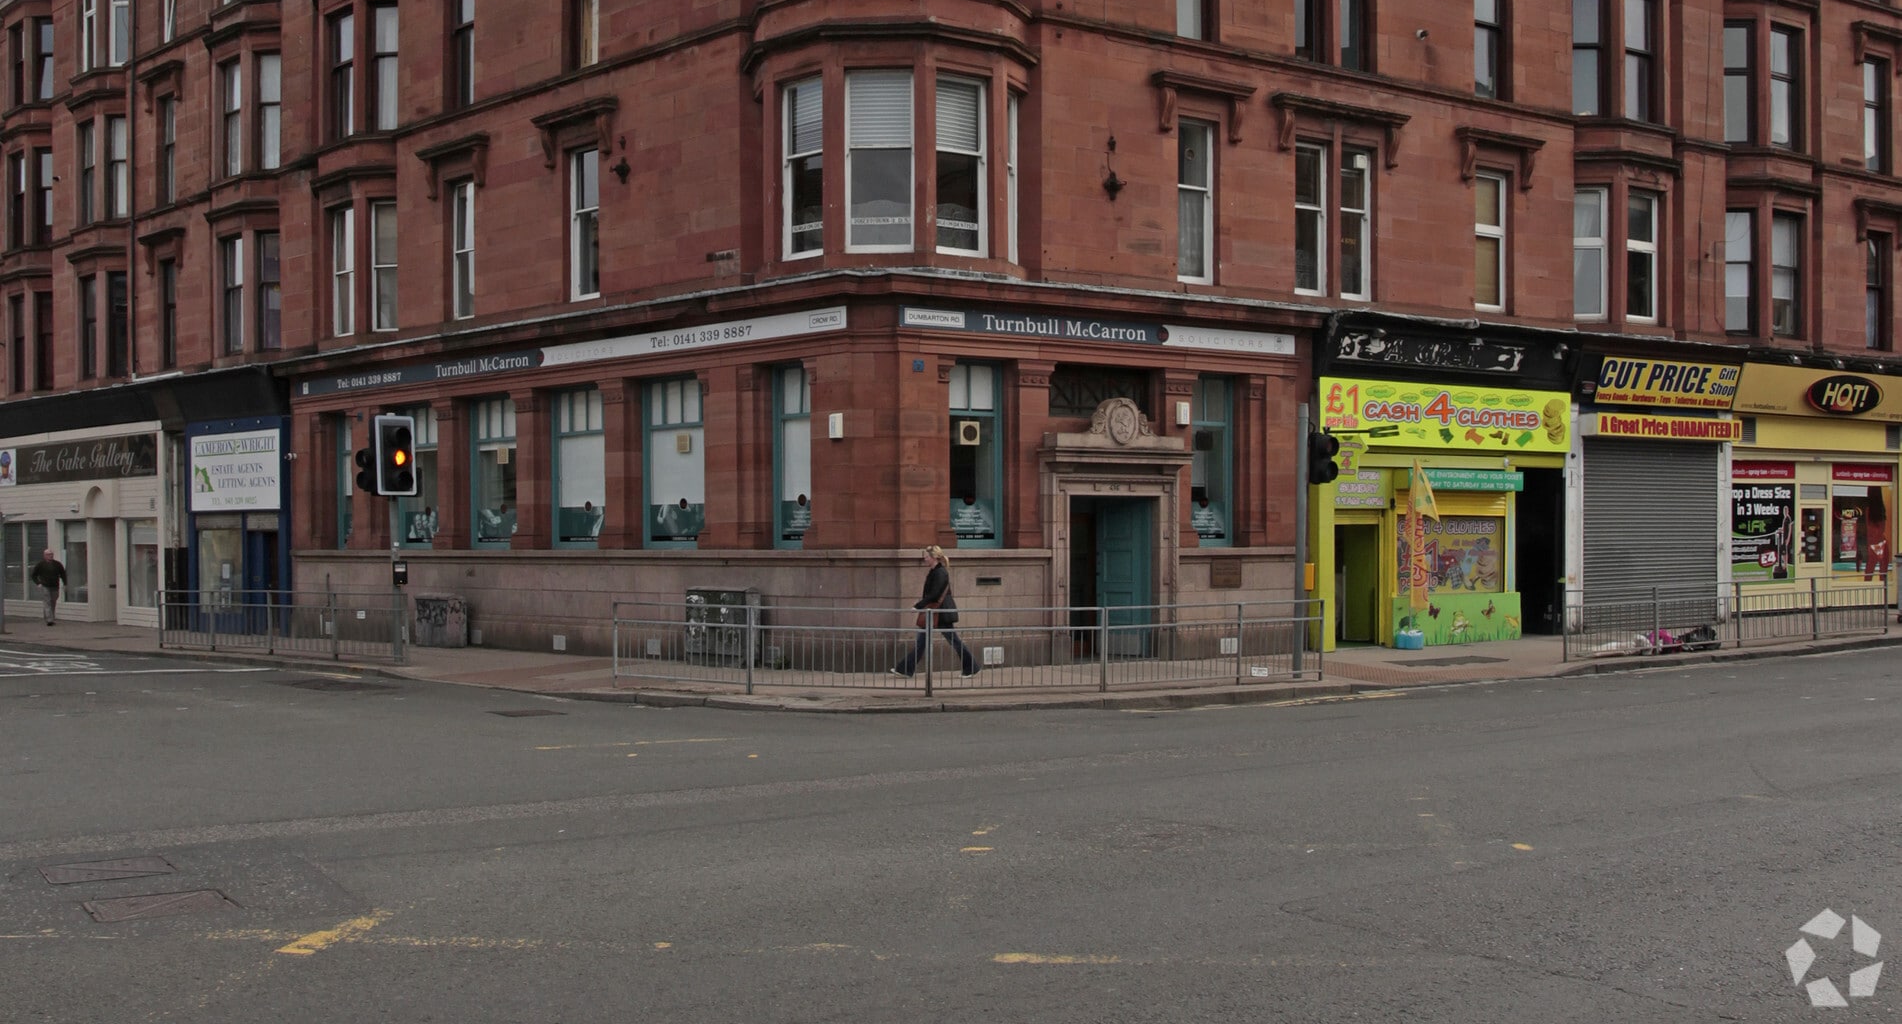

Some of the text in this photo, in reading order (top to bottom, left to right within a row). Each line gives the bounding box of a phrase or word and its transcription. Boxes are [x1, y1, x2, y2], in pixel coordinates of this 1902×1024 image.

[811, 315, 827, 325] CROW
[908, 312, 946, 324] DUMBARTON
[983, 313, 1147, 342] Turnbull McCarron
[650, 325, 753, 349] Tel: 0141 339 8887
[1178, 333, 1267, 350] SOLICITORS
[435, 355, 530, 378] Turnbull McCarron
[1719, 367, 1738, 381] Gift
[337, 371, 402, 389] Tel: 0141 339 8887
[1598, 358, 1713, 394] CUT PRICE
[1709, 382, 1736, 397] Shop
[1822, 382, 1870, 409] HOT!
[1325, 383, 1359, 415] £1
[1597, 391, 1612, 401] Fancy
[1612, 392, 1628, 401] Goods
[1632, 394, 1656, 403] Hardware
[1659, 395, 1671, 404] Toys
[1702, 398, 1716, 406] Much
[1363, 391, 1542, 429] CASH 4 CLOTHES
[1600, 416, 1608, 433] A
[1610, 416, 1639, 434] Great
[1642, 420, 1669, 435] Price
[1671, 421, 1731, 438] GUARANTEED
[195, 440, 233, 455] CAMERON
[240, 437, 276, 451] WRIGHT
[30, 442, 135, 476] The Cake Gallery
[211, 462, 263, 475] ESTATE AGENTS
[218, 476, 276, 489] LETTING AGENTS
[1339, 483, 1379, 494] SUNDAY
[1744, 489, 1751, 498] a
[1751, 487, 1774, 499] Dress
[1774, 487, 1791, 499] Size
[1737, 503, 1780, 515] in 3 Weeks
[1433, 521, 1443, 534] 4
[1445, 519, 1496, 535] CLOTHES
[1761, 551, 1777, 565] £4
